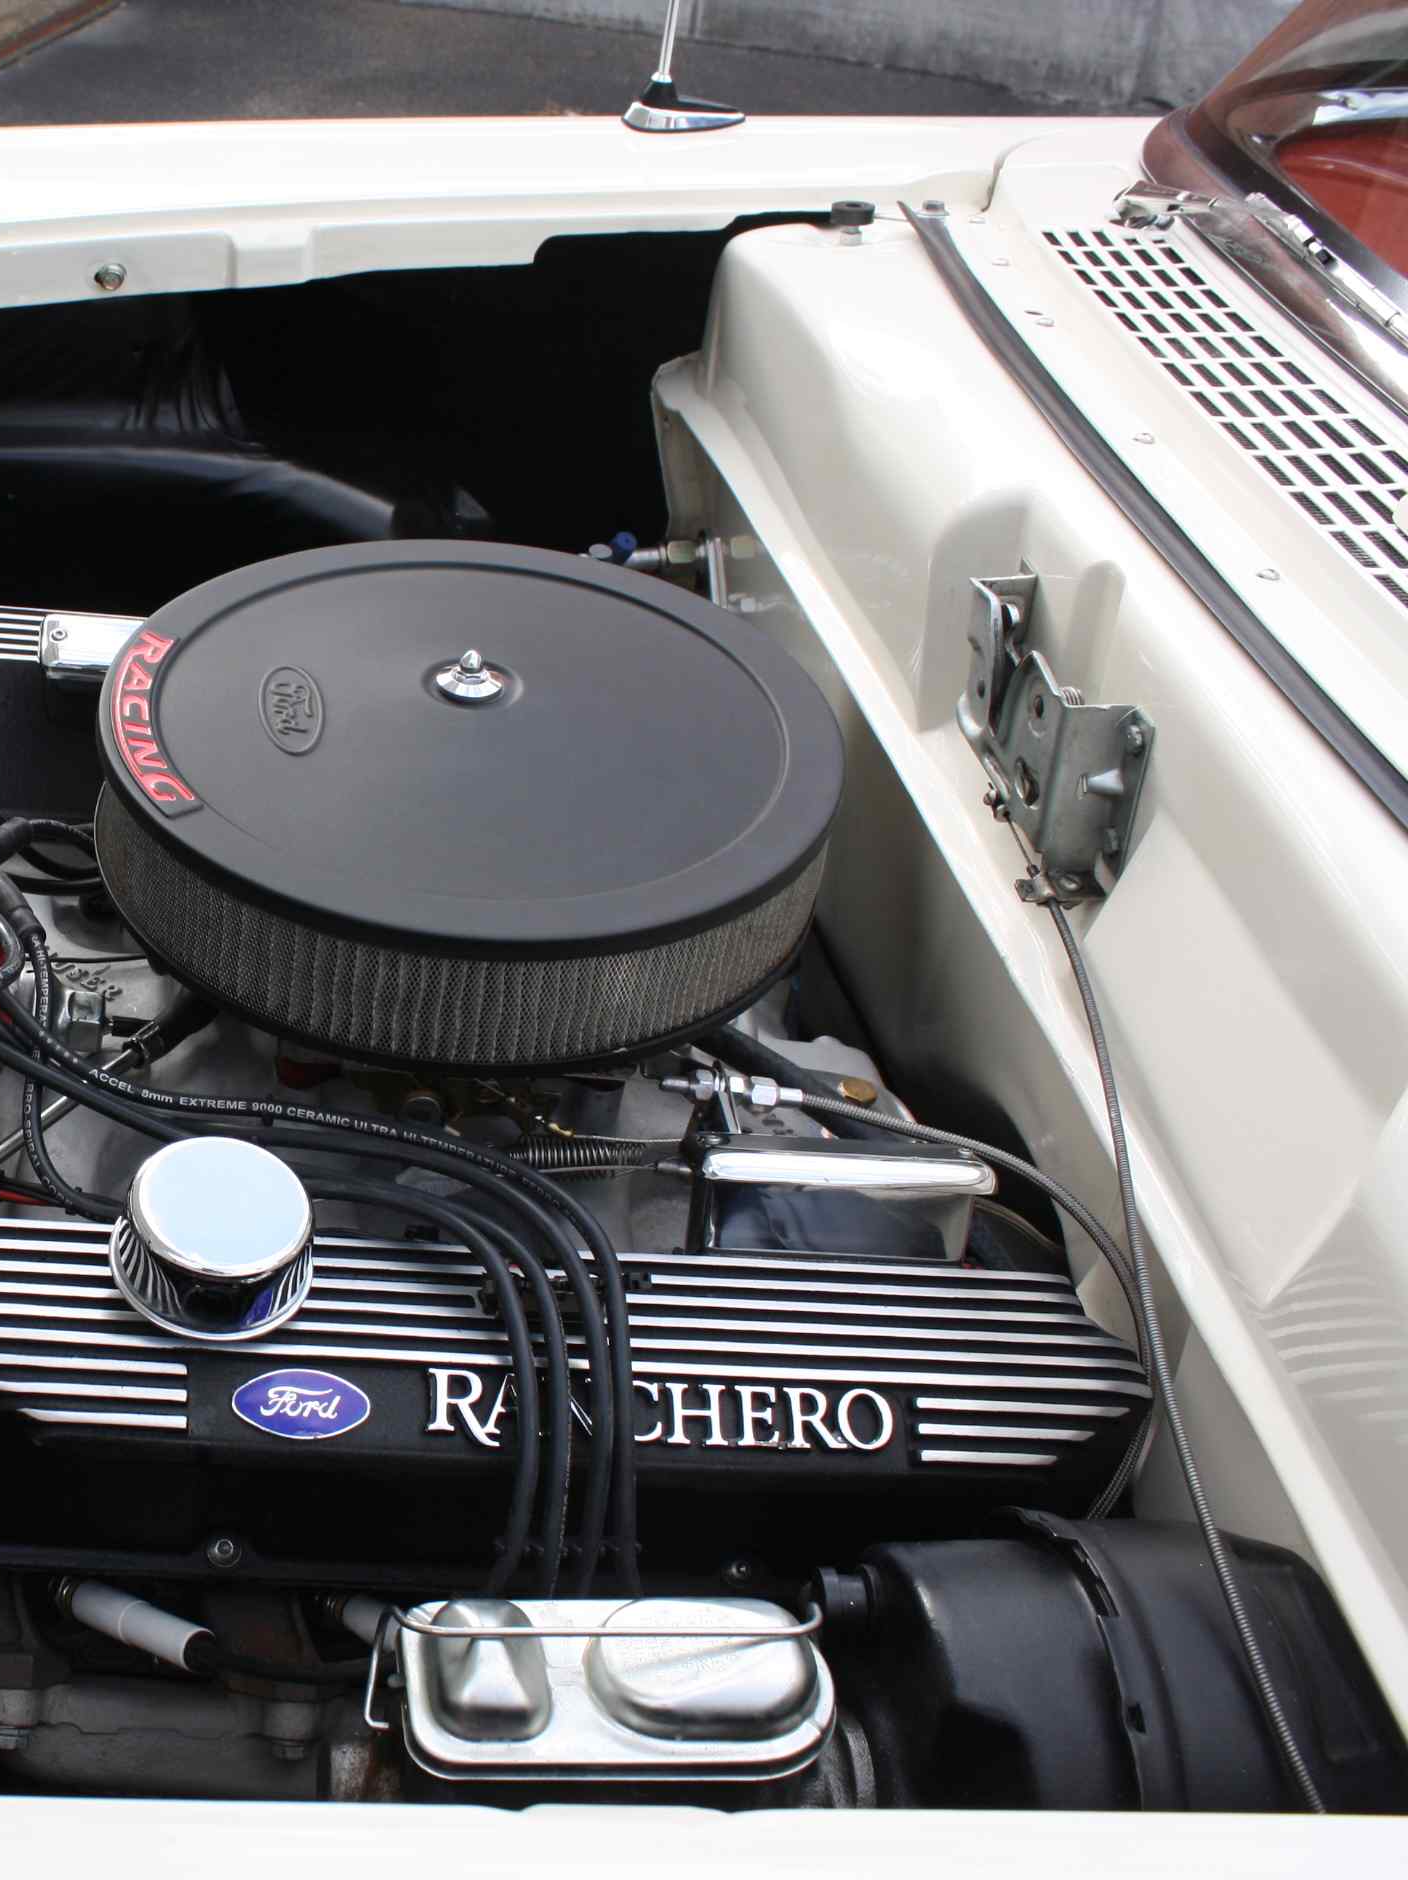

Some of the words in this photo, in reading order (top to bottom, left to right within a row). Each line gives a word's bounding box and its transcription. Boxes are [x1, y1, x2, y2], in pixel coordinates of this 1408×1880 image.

[112, 631, 195, 801] RACING
[269, 682, 313, 736] Ford
[89, 1068, 135, 1094] ACCEL
[141, 1089, 173, 1104] 8mm
[179, 1096, 247, 1111] EXTREME
[251, 1101, 282, 1114] 9000
[286, 1106, 350, 1129] CERAMIC
[353, 1119, 398, 1137] ULTRA
[260, 1386, 341, 1419] Ford
[426, 1367, 893, 1451] RACHERO
